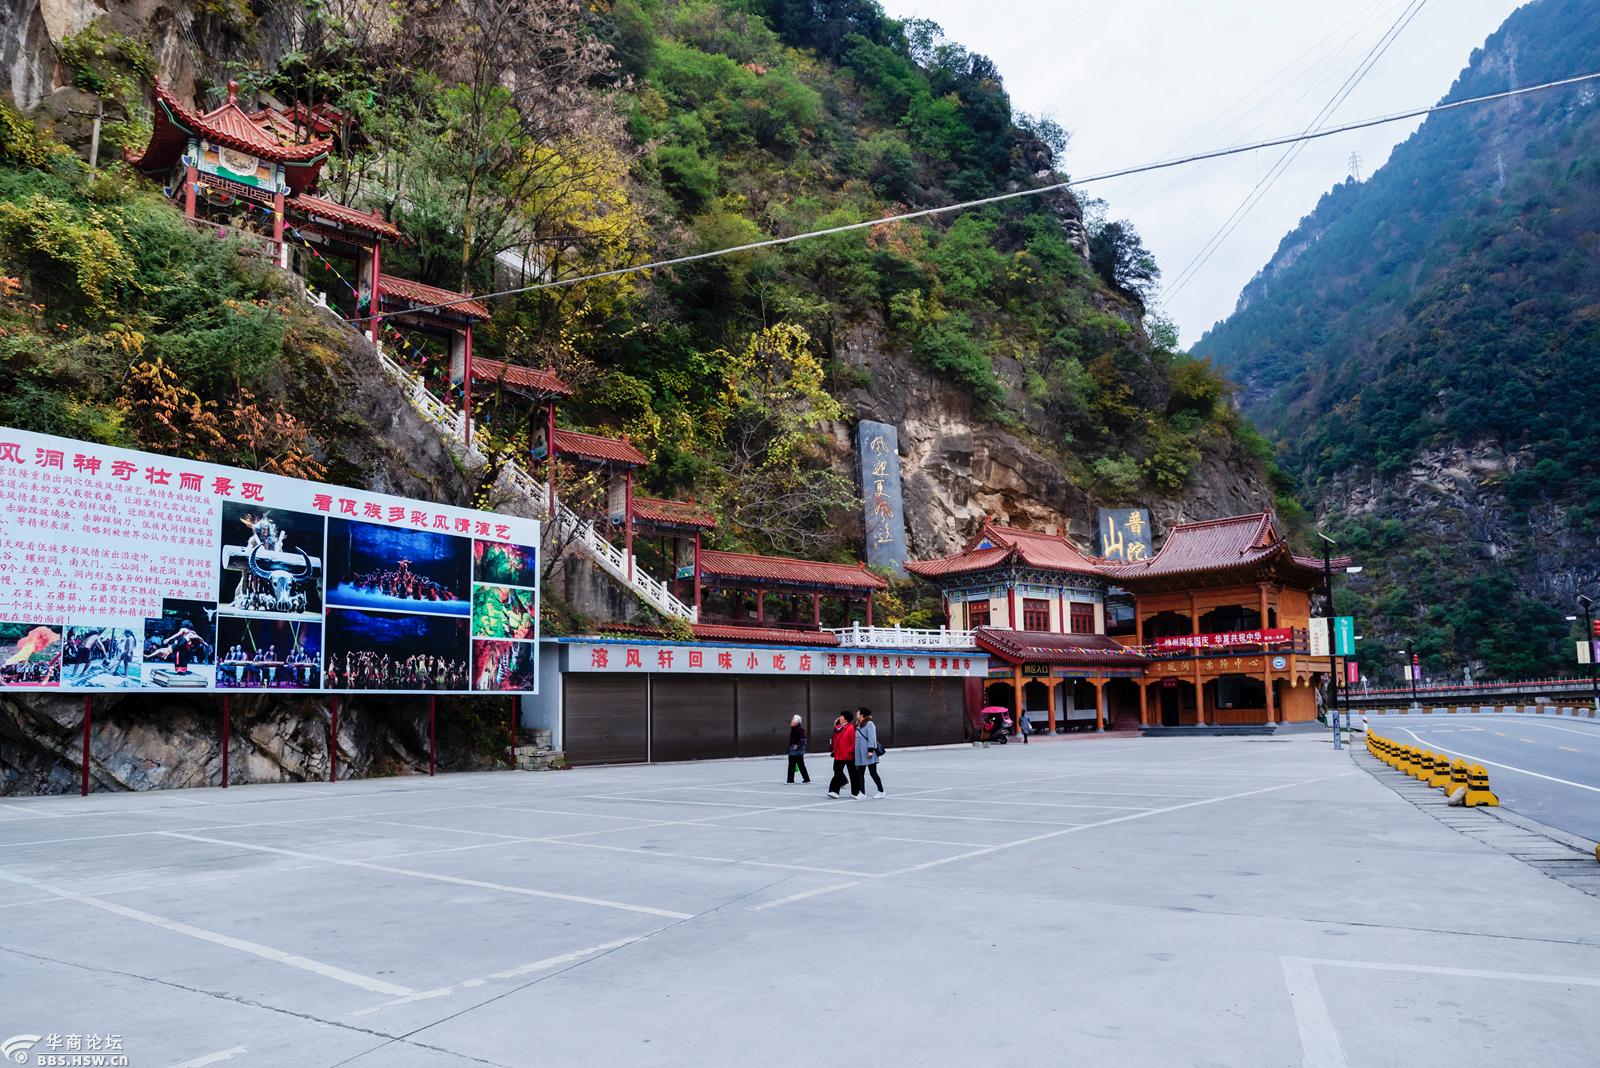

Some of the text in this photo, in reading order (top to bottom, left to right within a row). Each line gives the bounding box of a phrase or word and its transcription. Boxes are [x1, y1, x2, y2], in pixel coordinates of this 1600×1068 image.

[0, 442, 265, 502] 风洞神奇壮丽景观
[312, 493, 511, 541] 看佤族多彩风情演艺
[591, 647, 812, 672] 溶风轩回味小吃店
